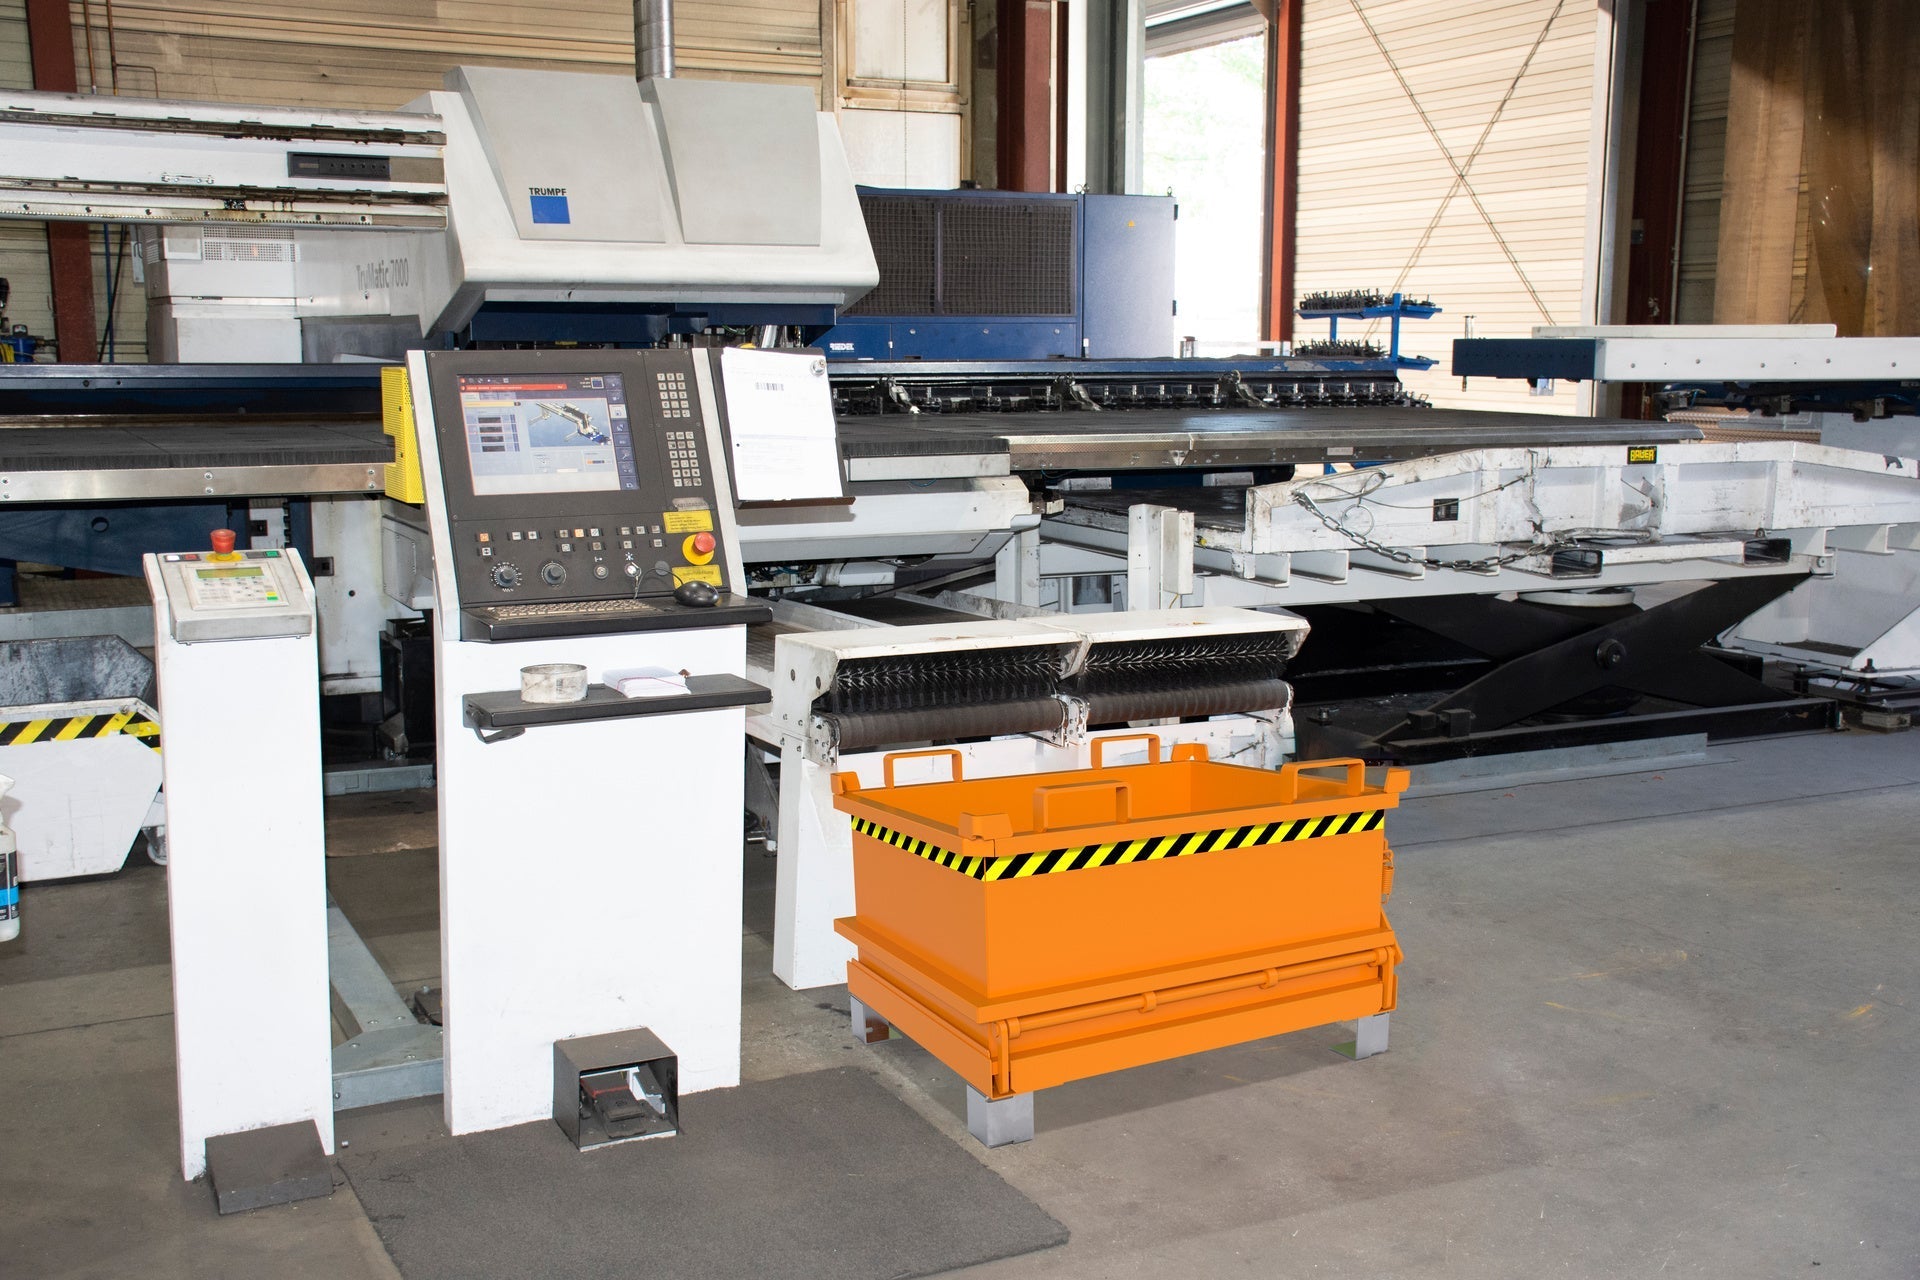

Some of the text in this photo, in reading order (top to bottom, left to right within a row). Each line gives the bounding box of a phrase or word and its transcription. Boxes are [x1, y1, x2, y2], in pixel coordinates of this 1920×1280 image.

[529, 187, 567, 196] TRUMPF
[356, 257, 409, 291] TruMatic 7000
[1630, 449, 1654, 461] BAUER
